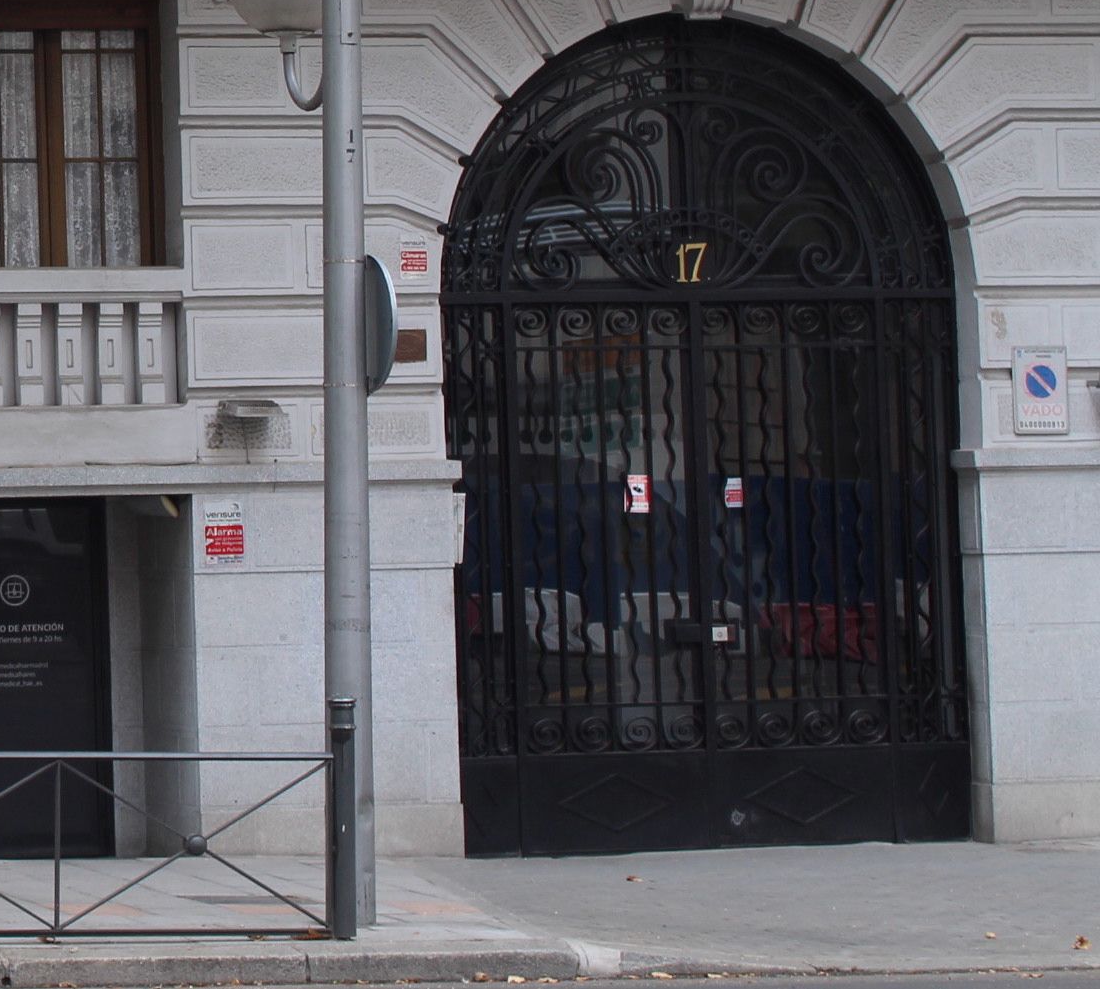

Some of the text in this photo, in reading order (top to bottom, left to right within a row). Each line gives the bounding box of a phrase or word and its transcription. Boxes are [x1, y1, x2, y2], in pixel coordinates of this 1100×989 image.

[675, 242, 708, 283] 17
[1021, 404, 1063, 417] VADO
[206, 527, 243, 537] Alarma
[8, 623, 20, 633] DE
[21, 622, 65, 632] ATENCIÓN
[22, 635, 32, 644] de
[44, 634, 53, 643] 20
